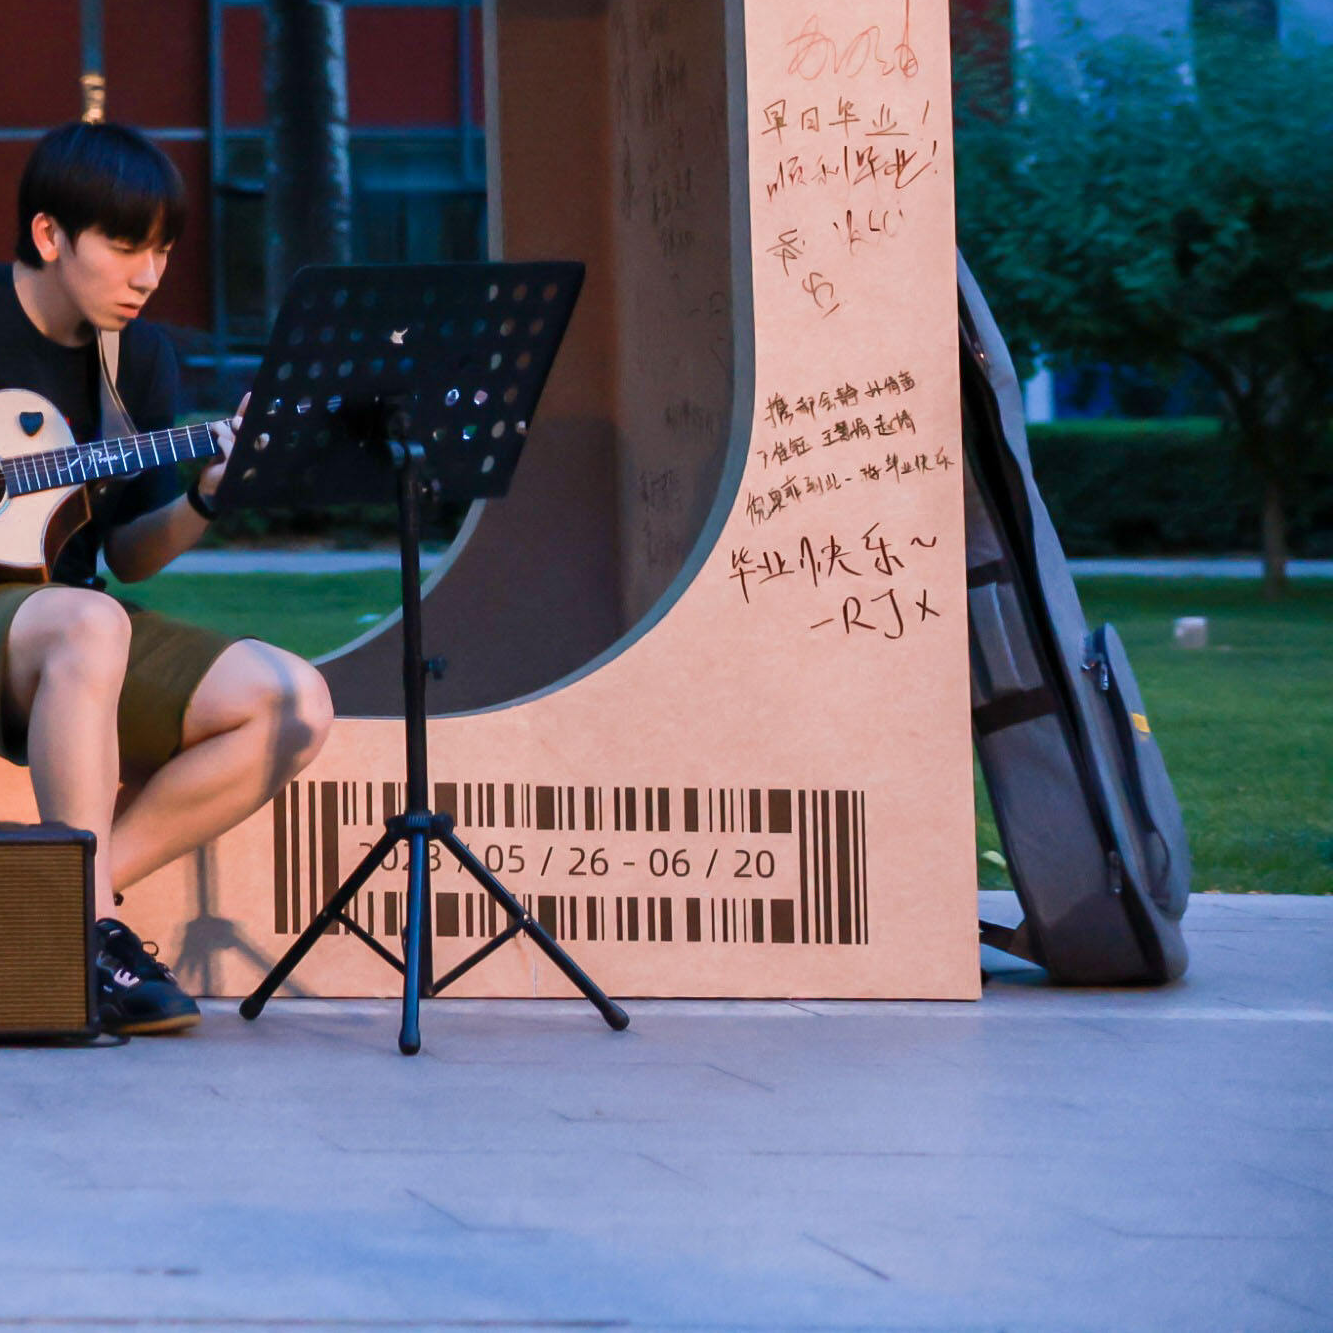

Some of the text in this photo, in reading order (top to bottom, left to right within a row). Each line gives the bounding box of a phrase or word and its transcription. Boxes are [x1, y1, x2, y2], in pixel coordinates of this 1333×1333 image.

[484, 843, 526, 874] 05
[568, 846, 610, 877] 26
[648, 847, 692, 878] 06
[732, 849, 776, 879] 20
